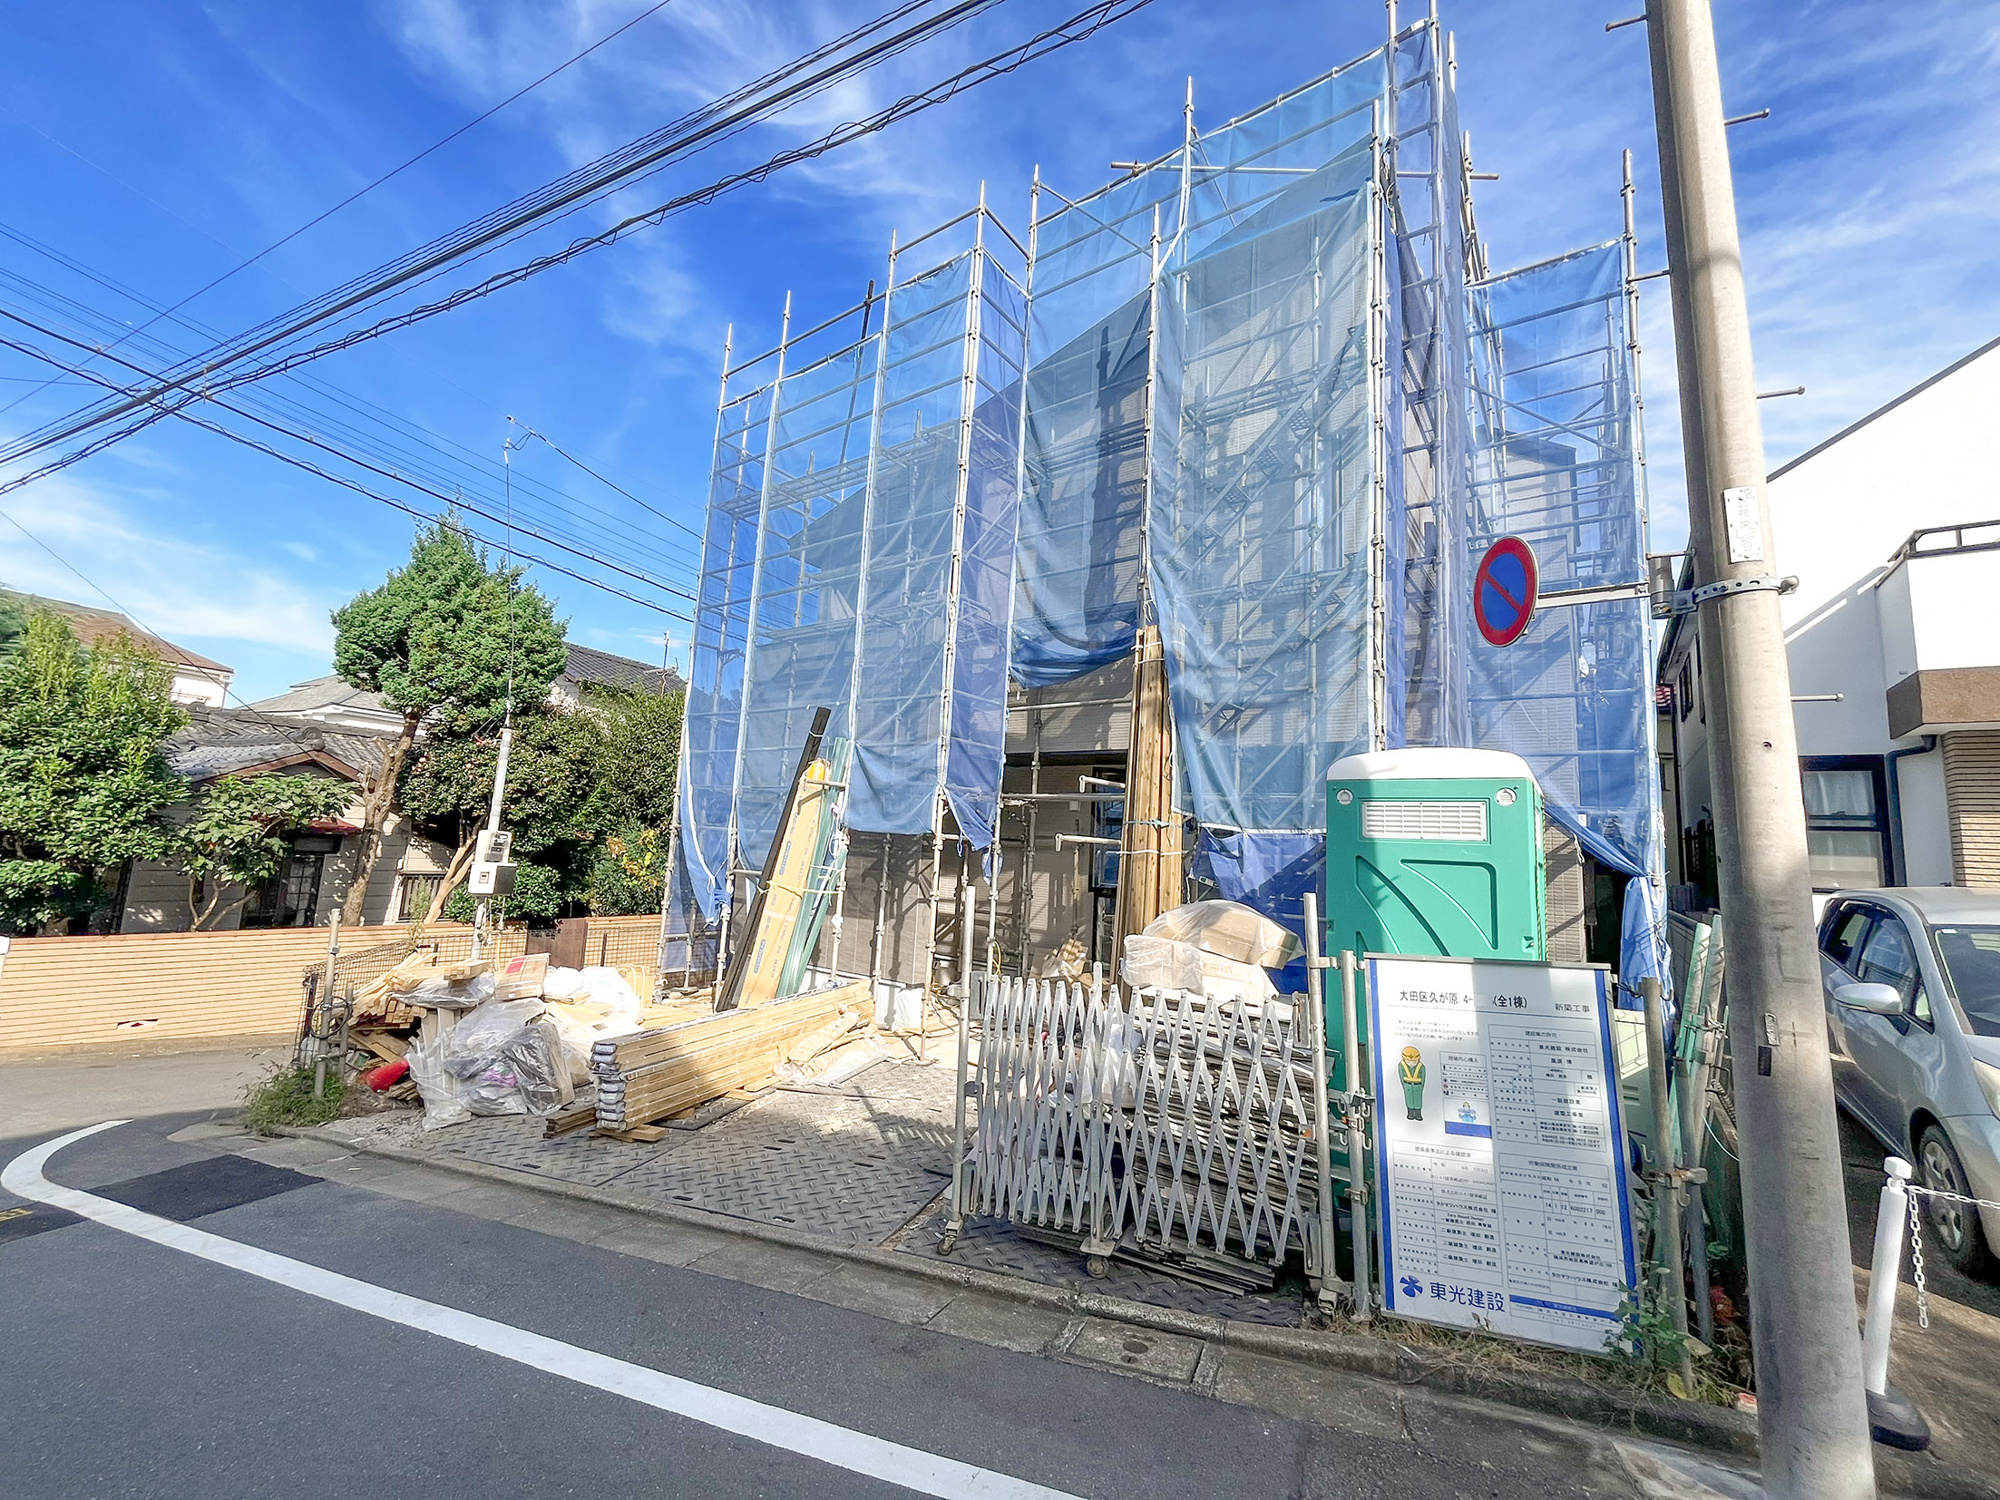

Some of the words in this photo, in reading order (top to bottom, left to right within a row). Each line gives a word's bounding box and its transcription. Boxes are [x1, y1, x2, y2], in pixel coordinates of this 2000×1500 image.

[1400, 990, 1459, 1005] 大田区久が原
[1492, 995, 1528, 1009] (全1棟)
[1555, 1003, 1590, 1013] 新築工事
[1430, 1282, 1505, 1312] 東光建設
